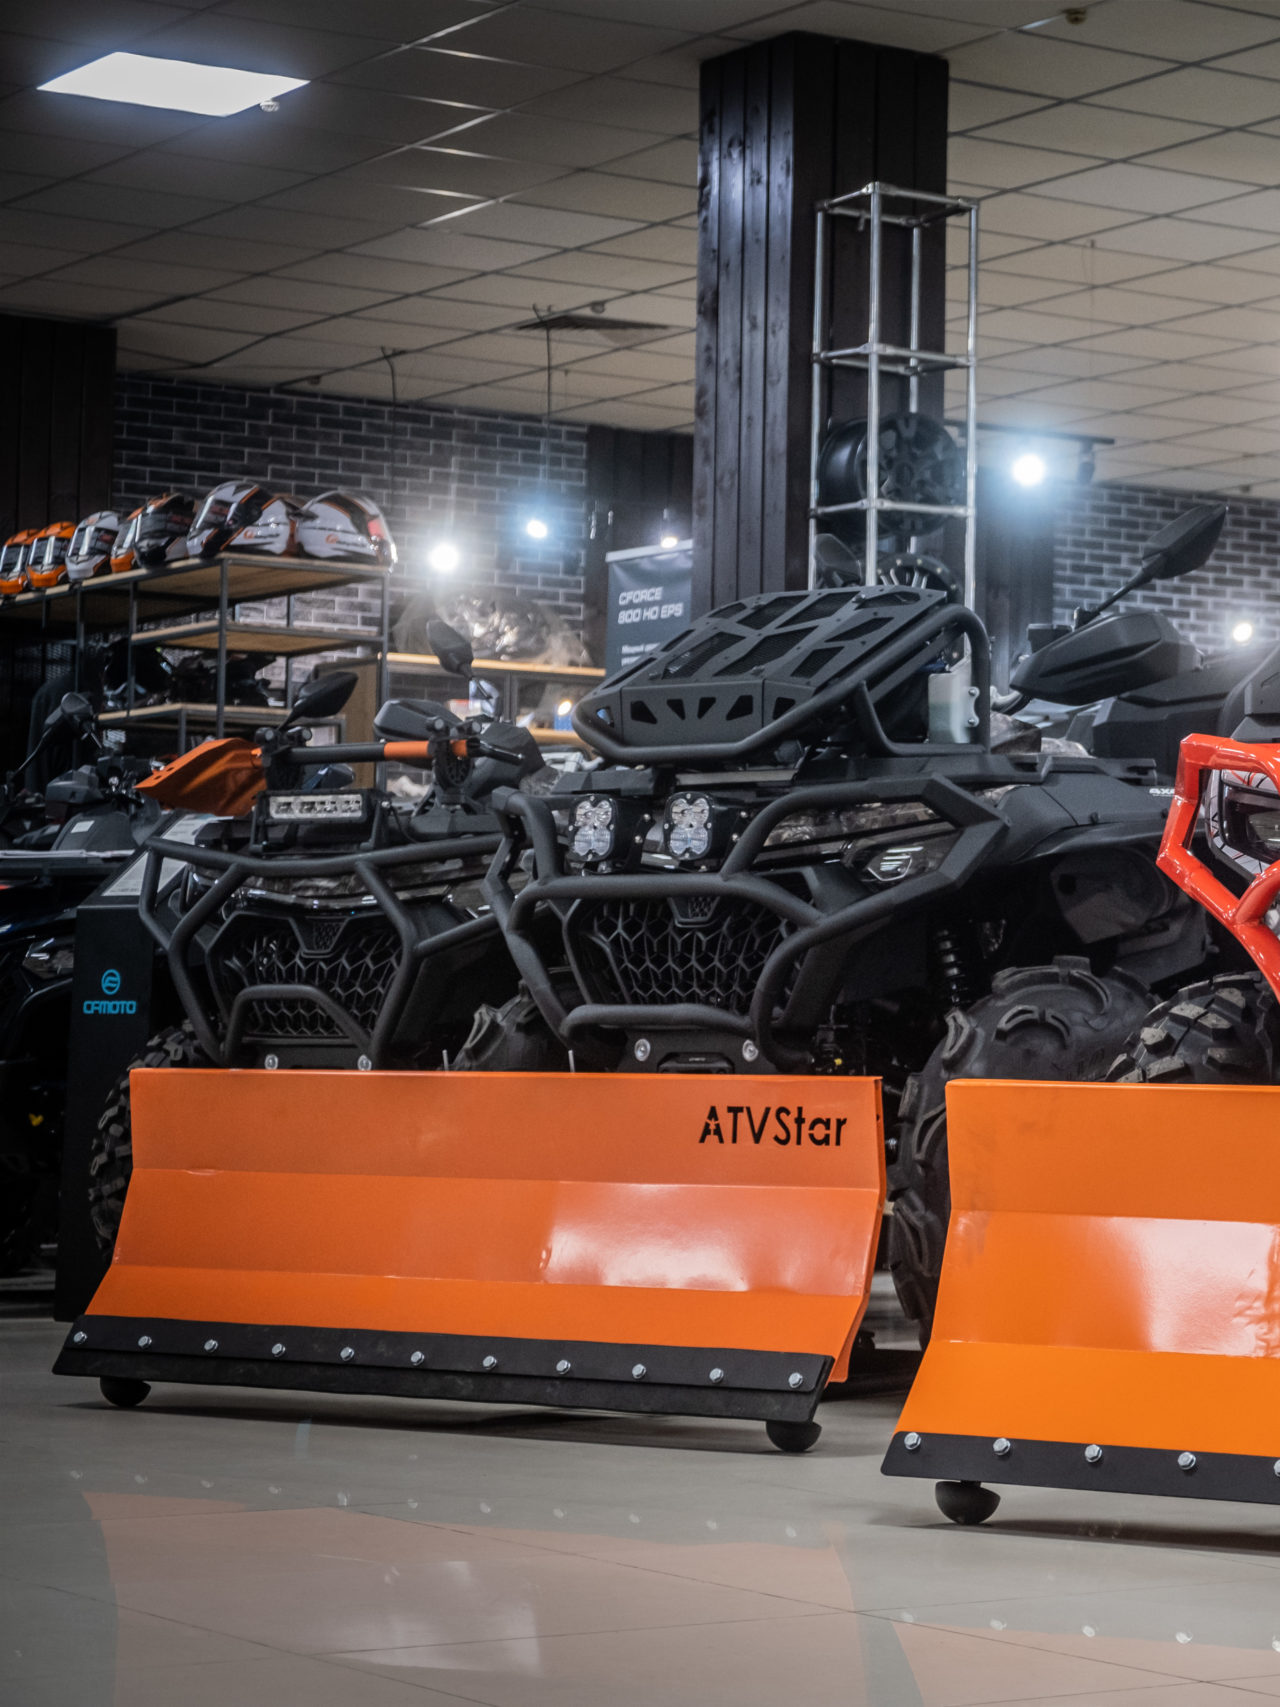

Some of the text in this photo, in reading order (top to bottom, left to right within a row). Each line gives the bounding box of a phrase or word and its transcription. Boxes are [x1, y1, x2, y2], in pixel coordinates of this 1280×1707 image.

[618, 586, 664, 606] CFORCE
[617, 602, 684, 625] 800 HO EPS
[698, 1105, 848, 1146] ATVStar
